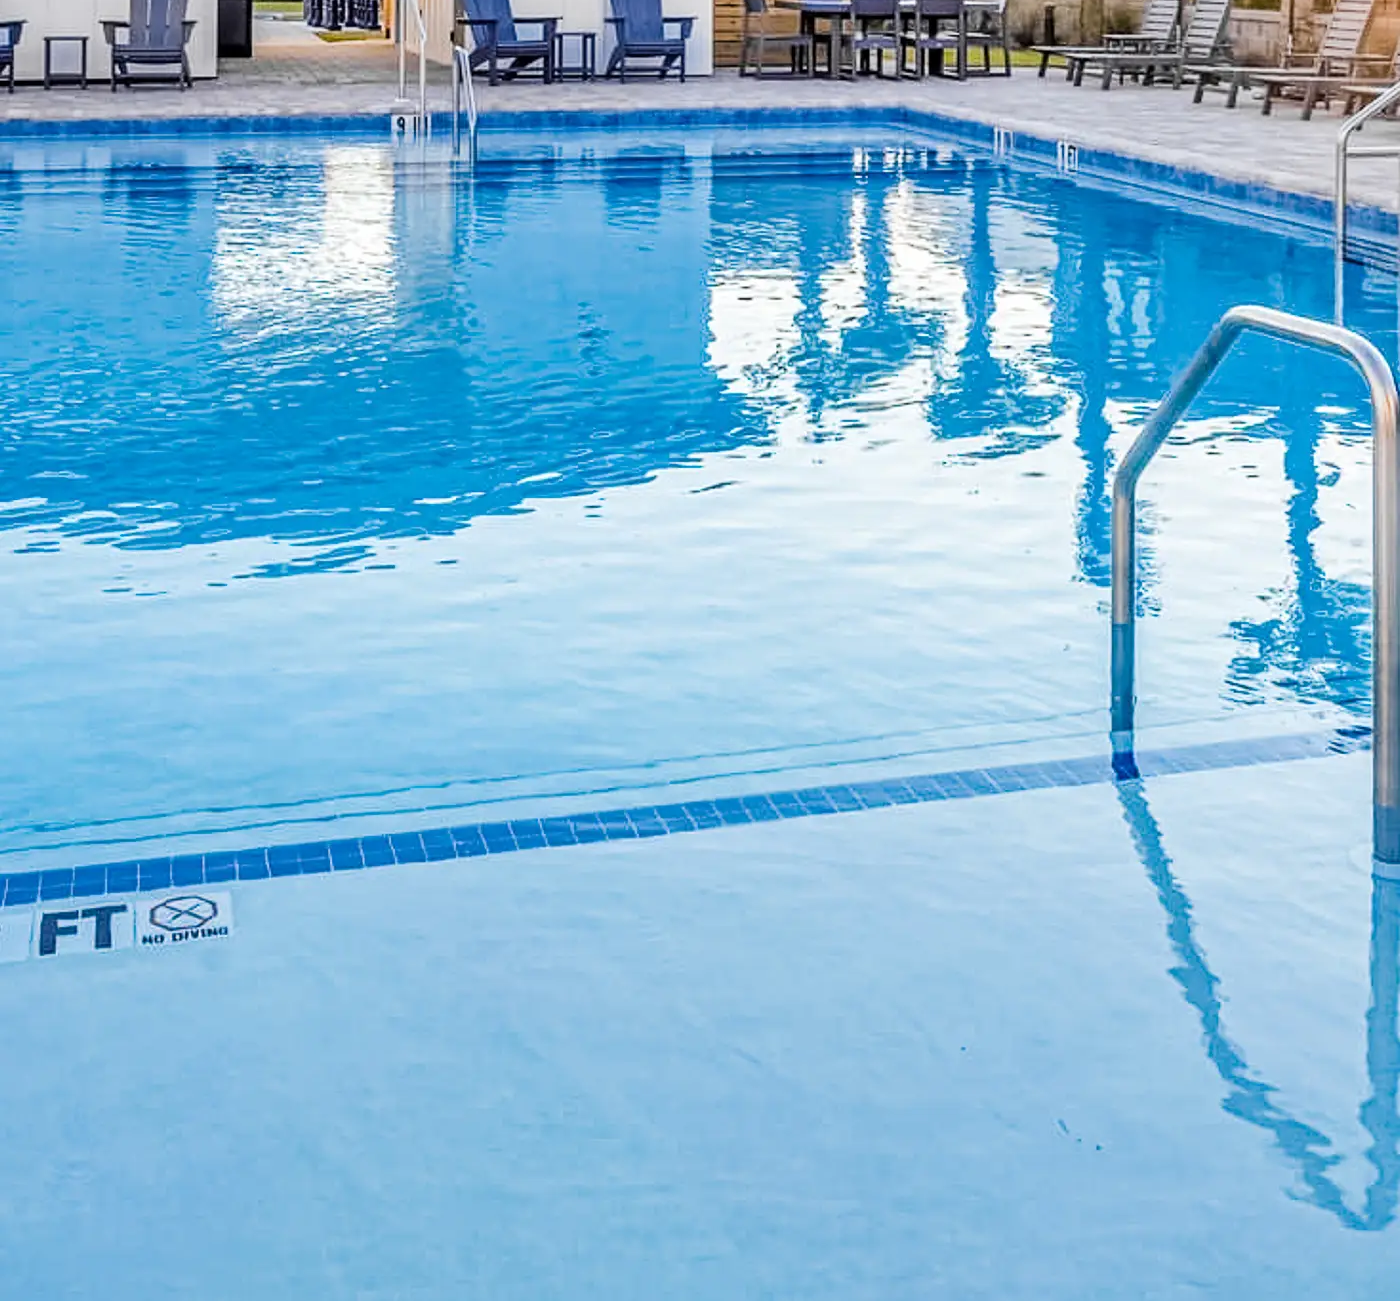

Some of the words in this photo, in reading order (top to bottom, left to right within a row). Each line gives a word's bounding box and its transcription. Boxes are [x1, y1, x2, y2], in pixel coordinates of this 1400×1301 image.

[39, 904, 128, 957] FT
[142, 934, 165, 945] NO
[171, 926, 229, 943] DIVING
